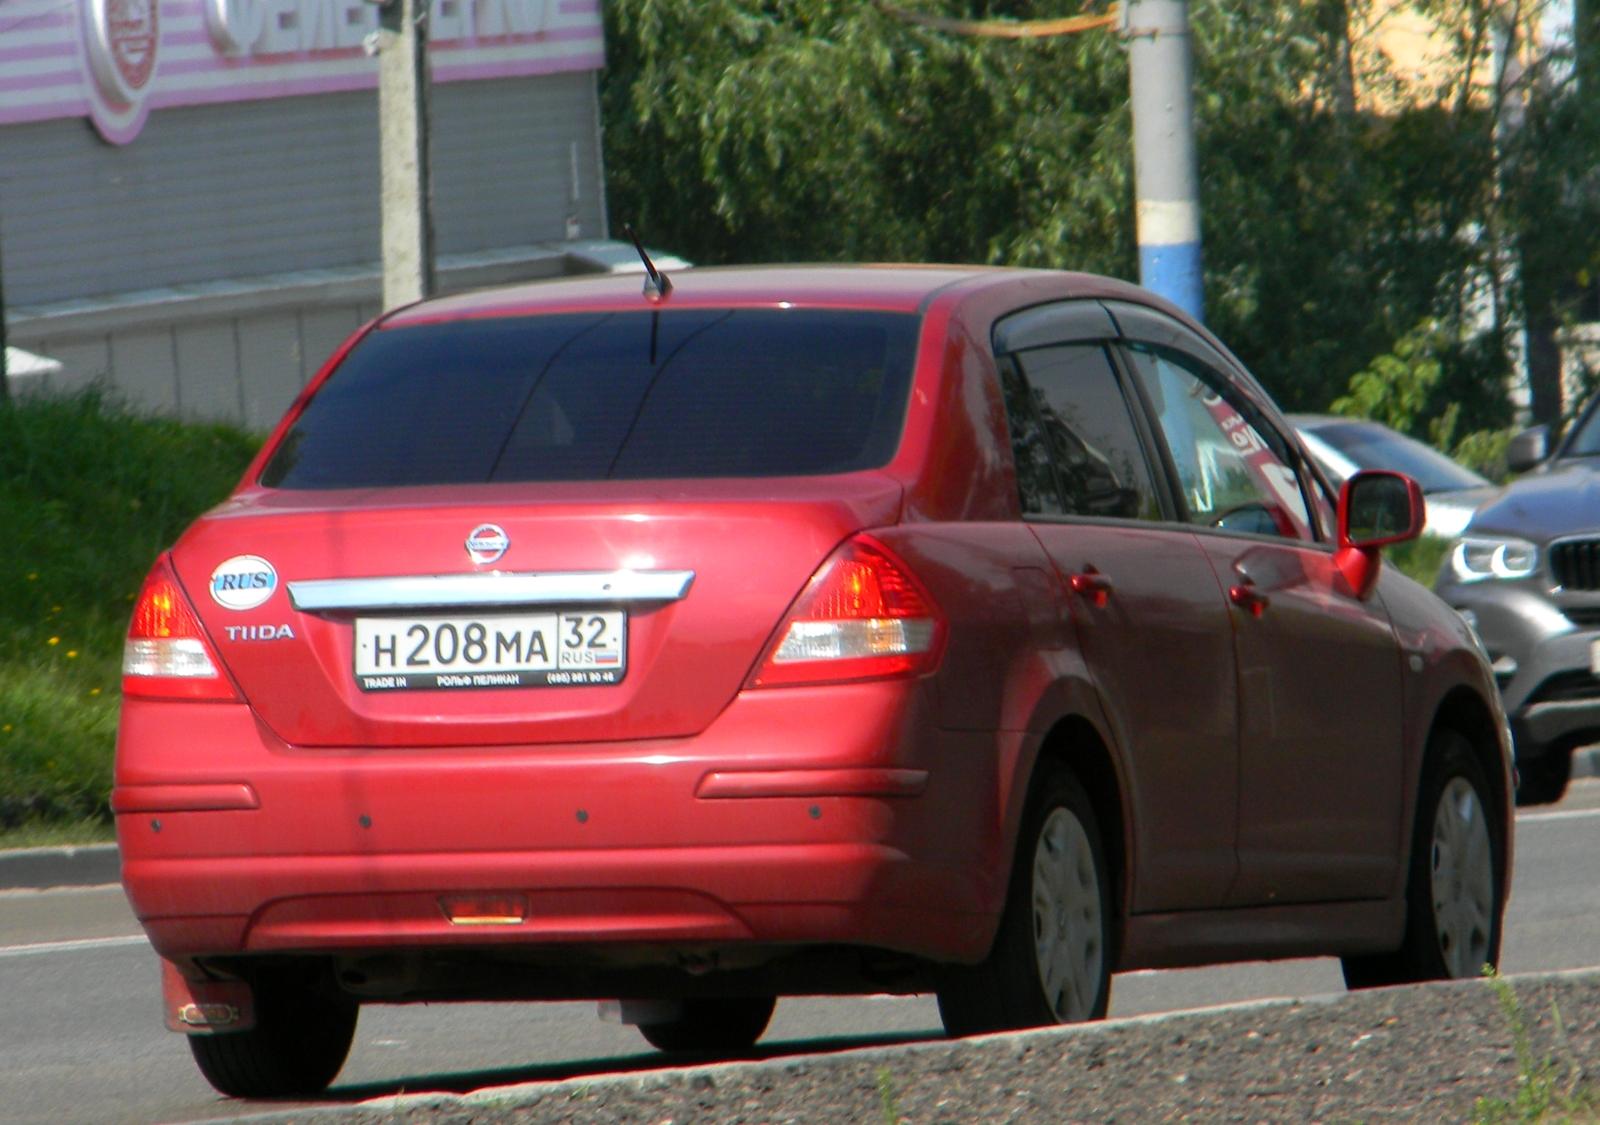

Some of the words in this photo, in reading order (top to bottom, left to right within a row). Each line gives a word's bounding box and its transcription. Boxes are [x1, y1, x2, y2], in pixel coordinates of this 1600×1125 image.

[222, 571, 268, 590] RUS
[224, 624, 295, 641] TIIDA
[564, 616, 607, 649] 32
[562, 651, 594, 664] RUS
[363, 676, 395, 689] TRADE
[396, 675, 407, 687] IN
